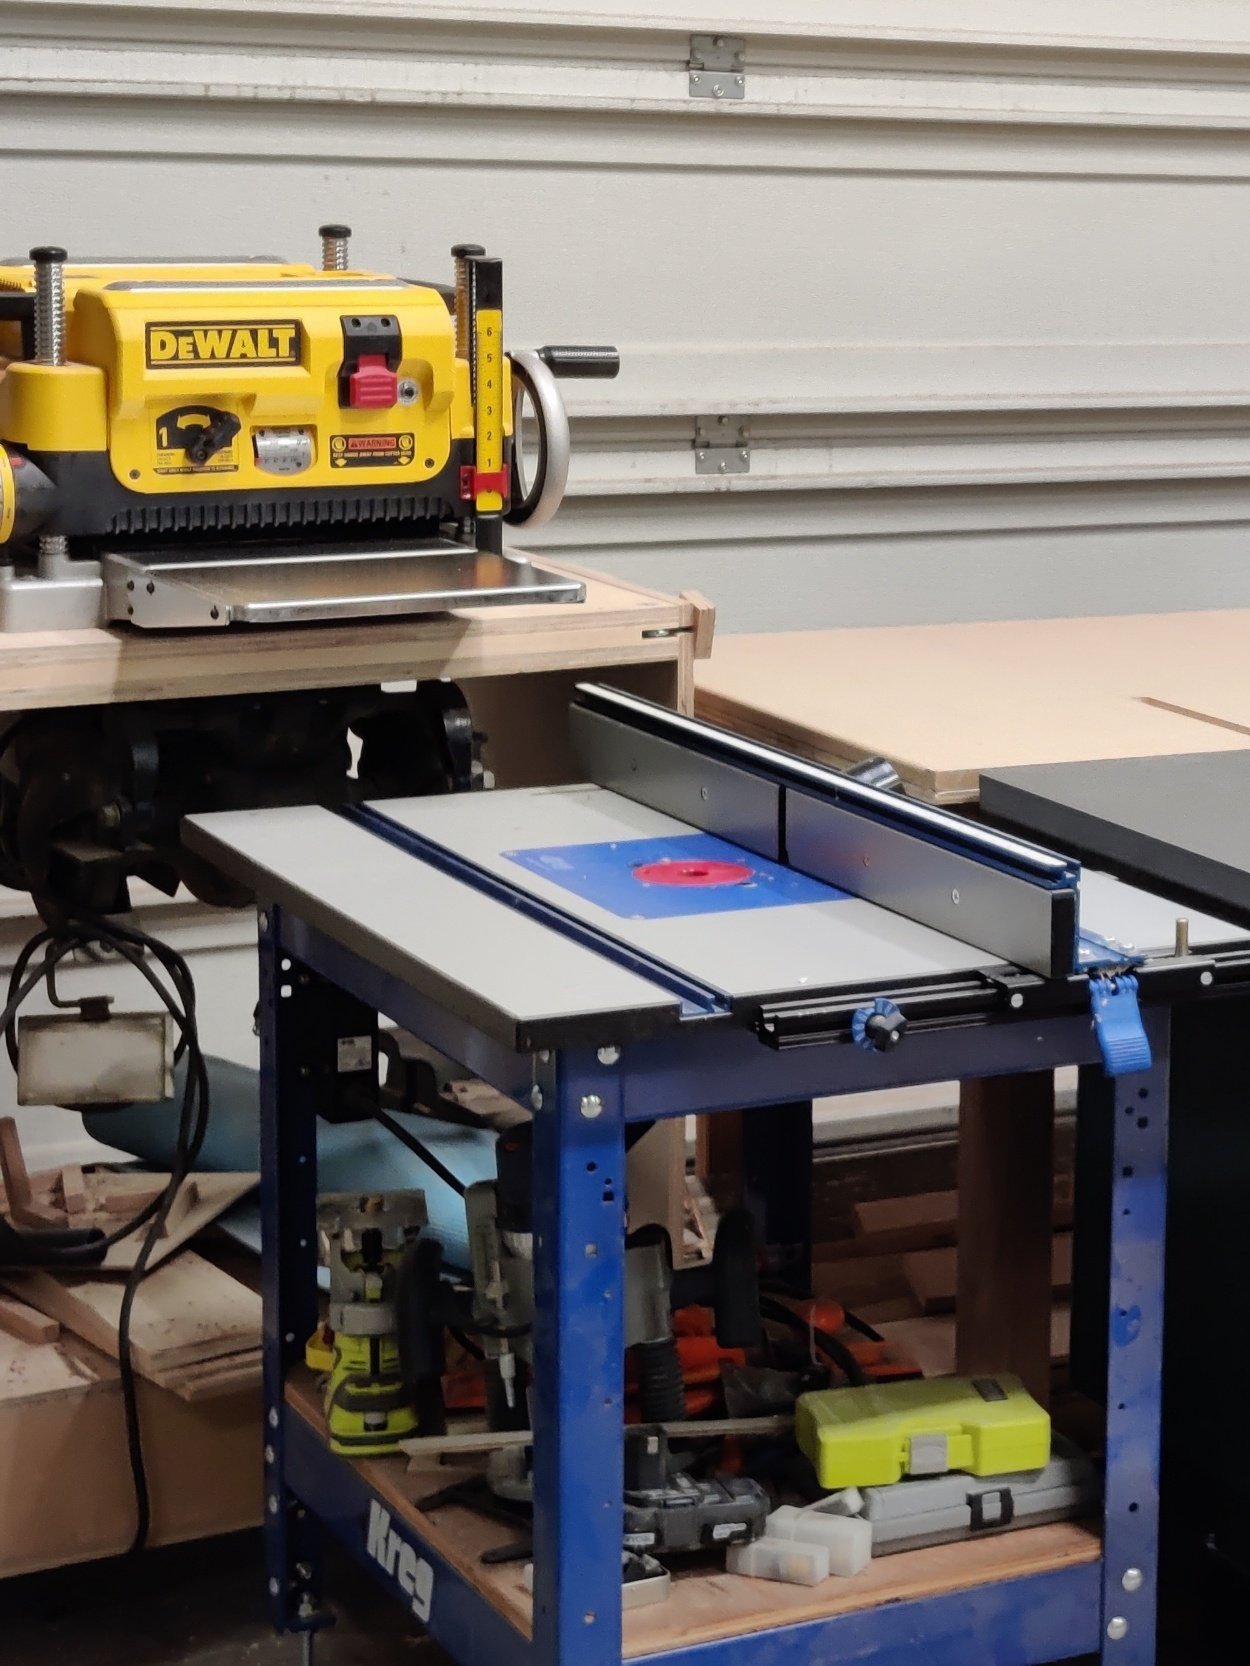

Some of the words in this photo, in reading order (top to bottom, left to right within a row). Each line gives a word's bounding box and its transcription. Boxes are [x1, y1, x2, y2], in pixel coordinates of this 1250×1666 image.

[486, 327, 493, 337] 6
[486, 353, 493, 363] 5
[486, 379, 493, 389] 4
[486, 405, 493, 415] 3
[159, 426, 168, 447] 1
[486, 431, 492, 441] 2
[359, 438, 395, 448] WARNING
[487, 459, 492, 467] 1
[366, 1498, 434, 1623] Kreg
